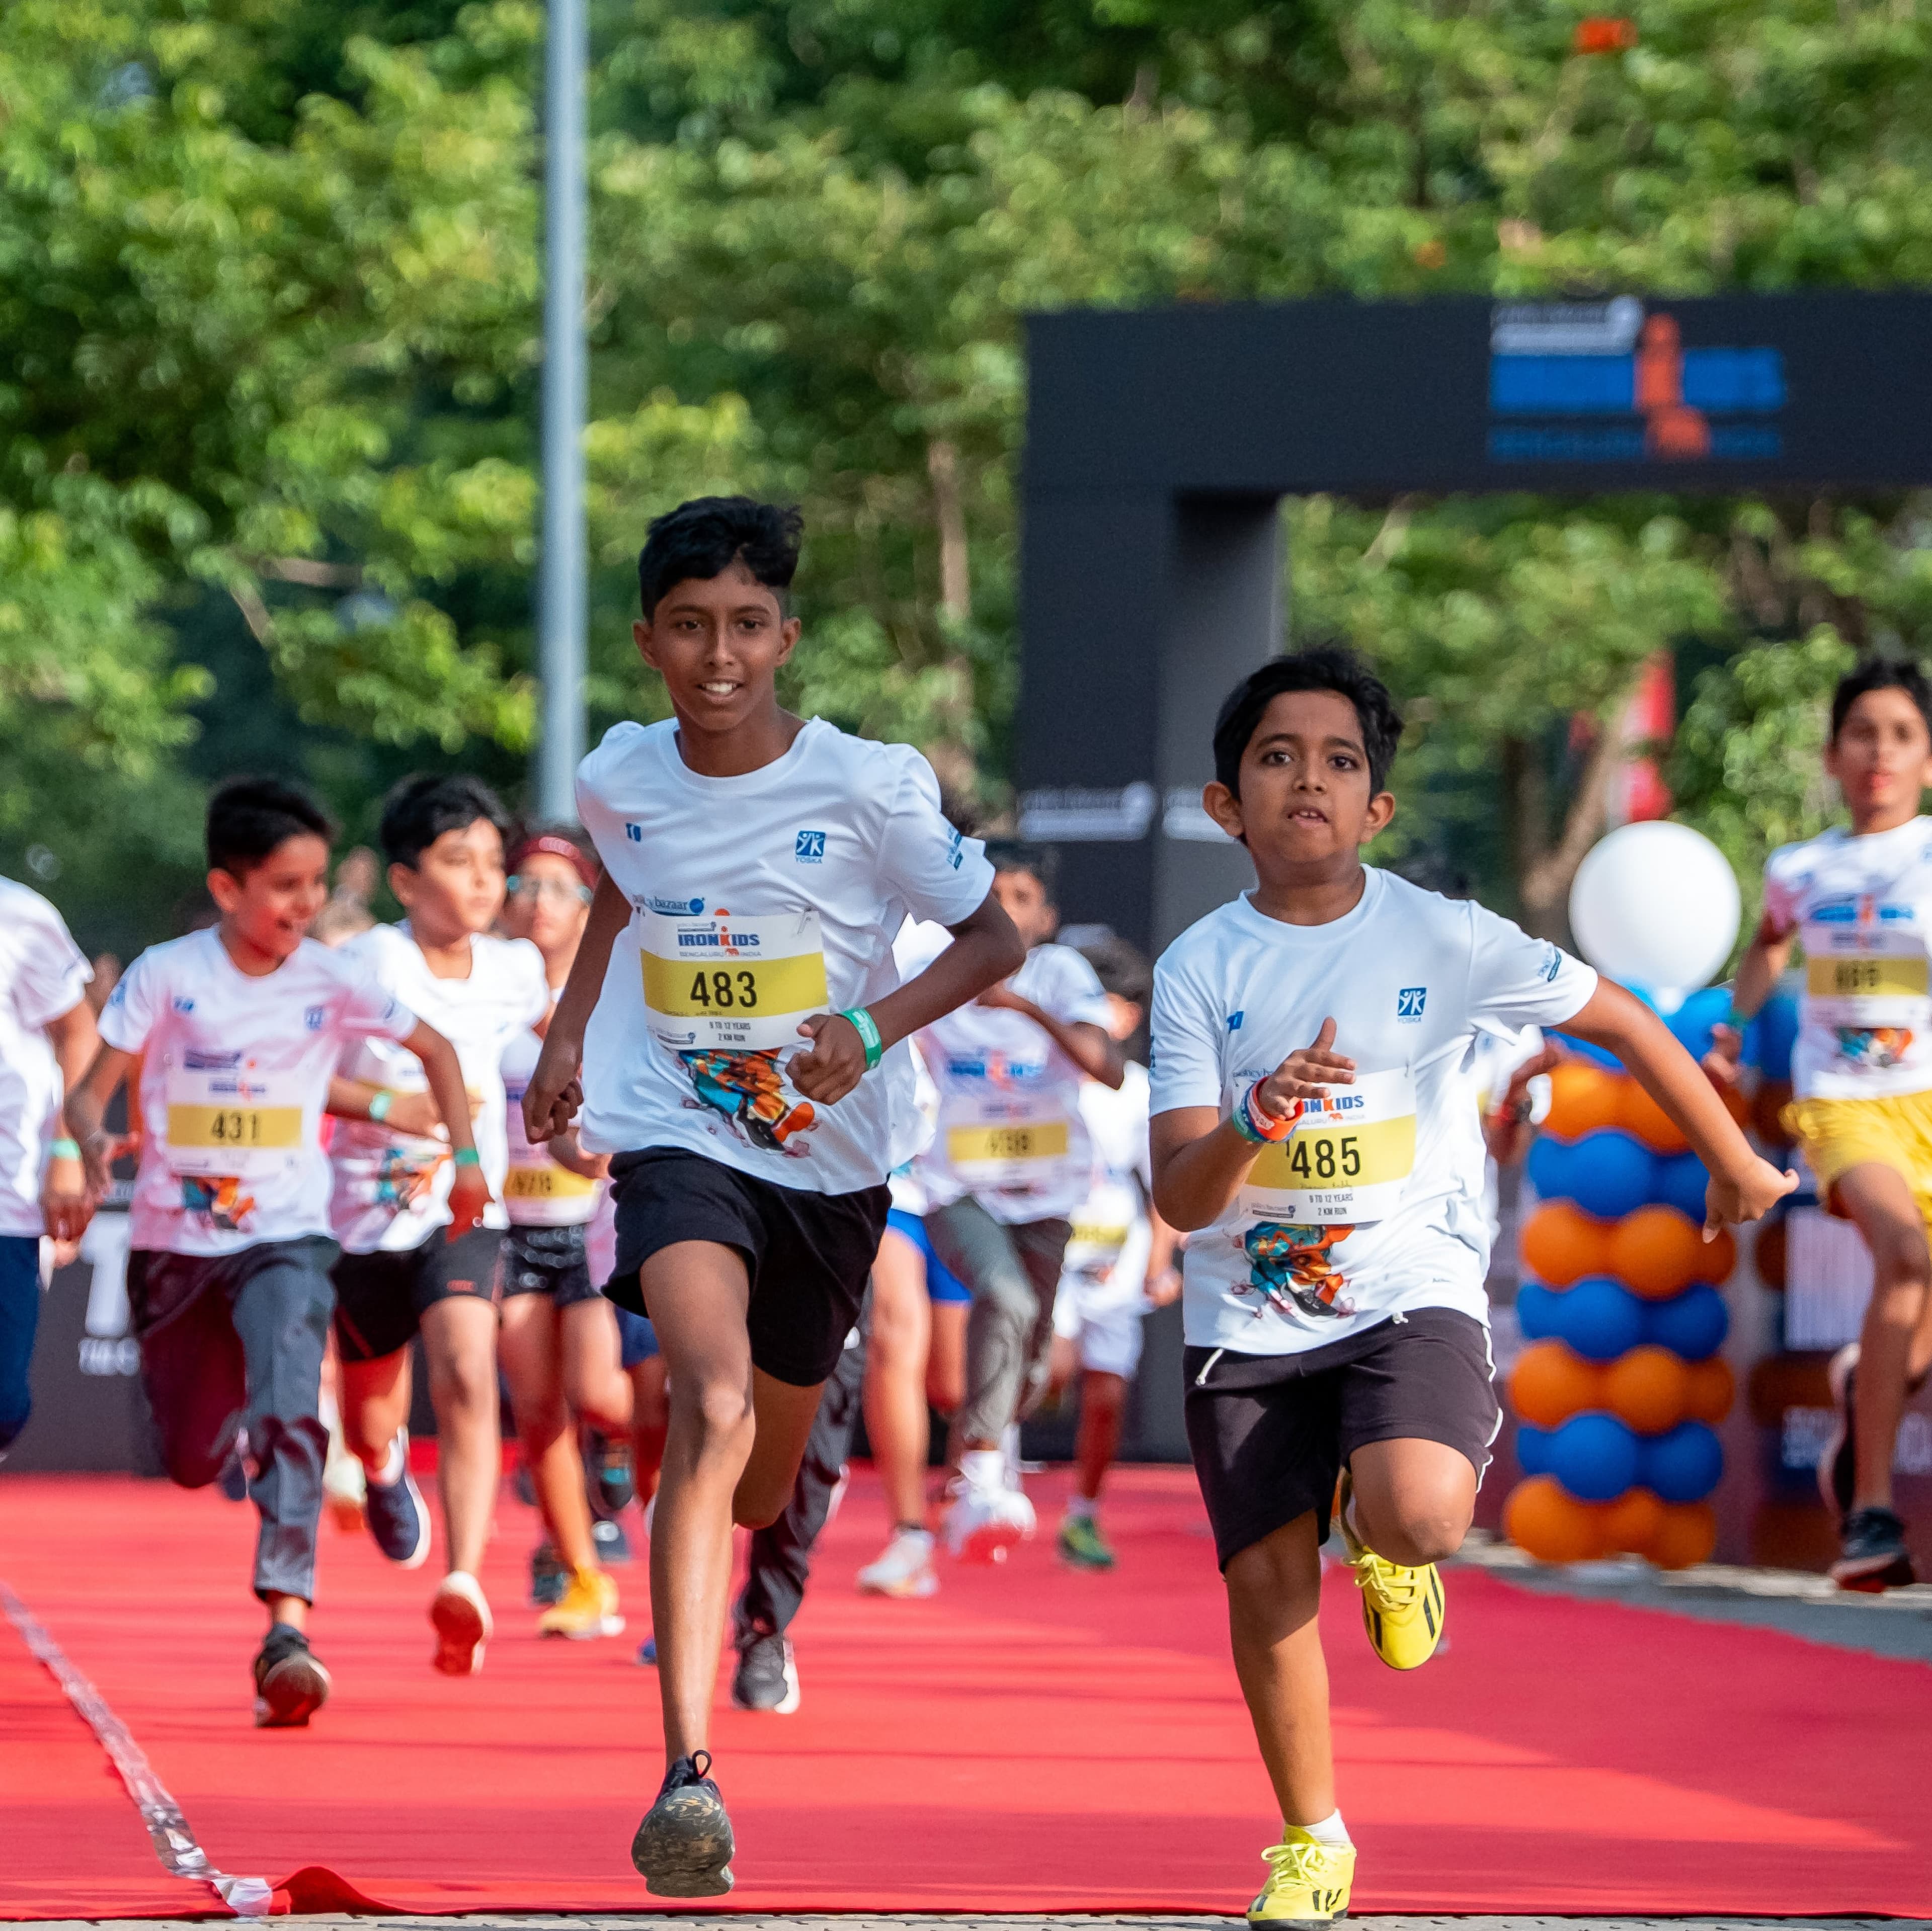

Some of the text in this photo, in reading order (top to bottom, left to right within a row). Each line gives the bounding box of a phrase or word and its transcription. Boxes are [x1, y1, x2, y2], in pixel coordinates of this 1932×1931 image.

[690, 971, 757, 1008] 483
[733, 1022, 751, 1030] YEARS
[210, 1111, 258, 1139] 431
[1291, 1136, 1361, 1179] 485
[1315, 1195, 1323, 1203] TO
[1325, 1195, 1332, 1203] 12
[1333, 1193, 1353, 1202] YEARS
[1318, 1207, 1322, 1216] 2
